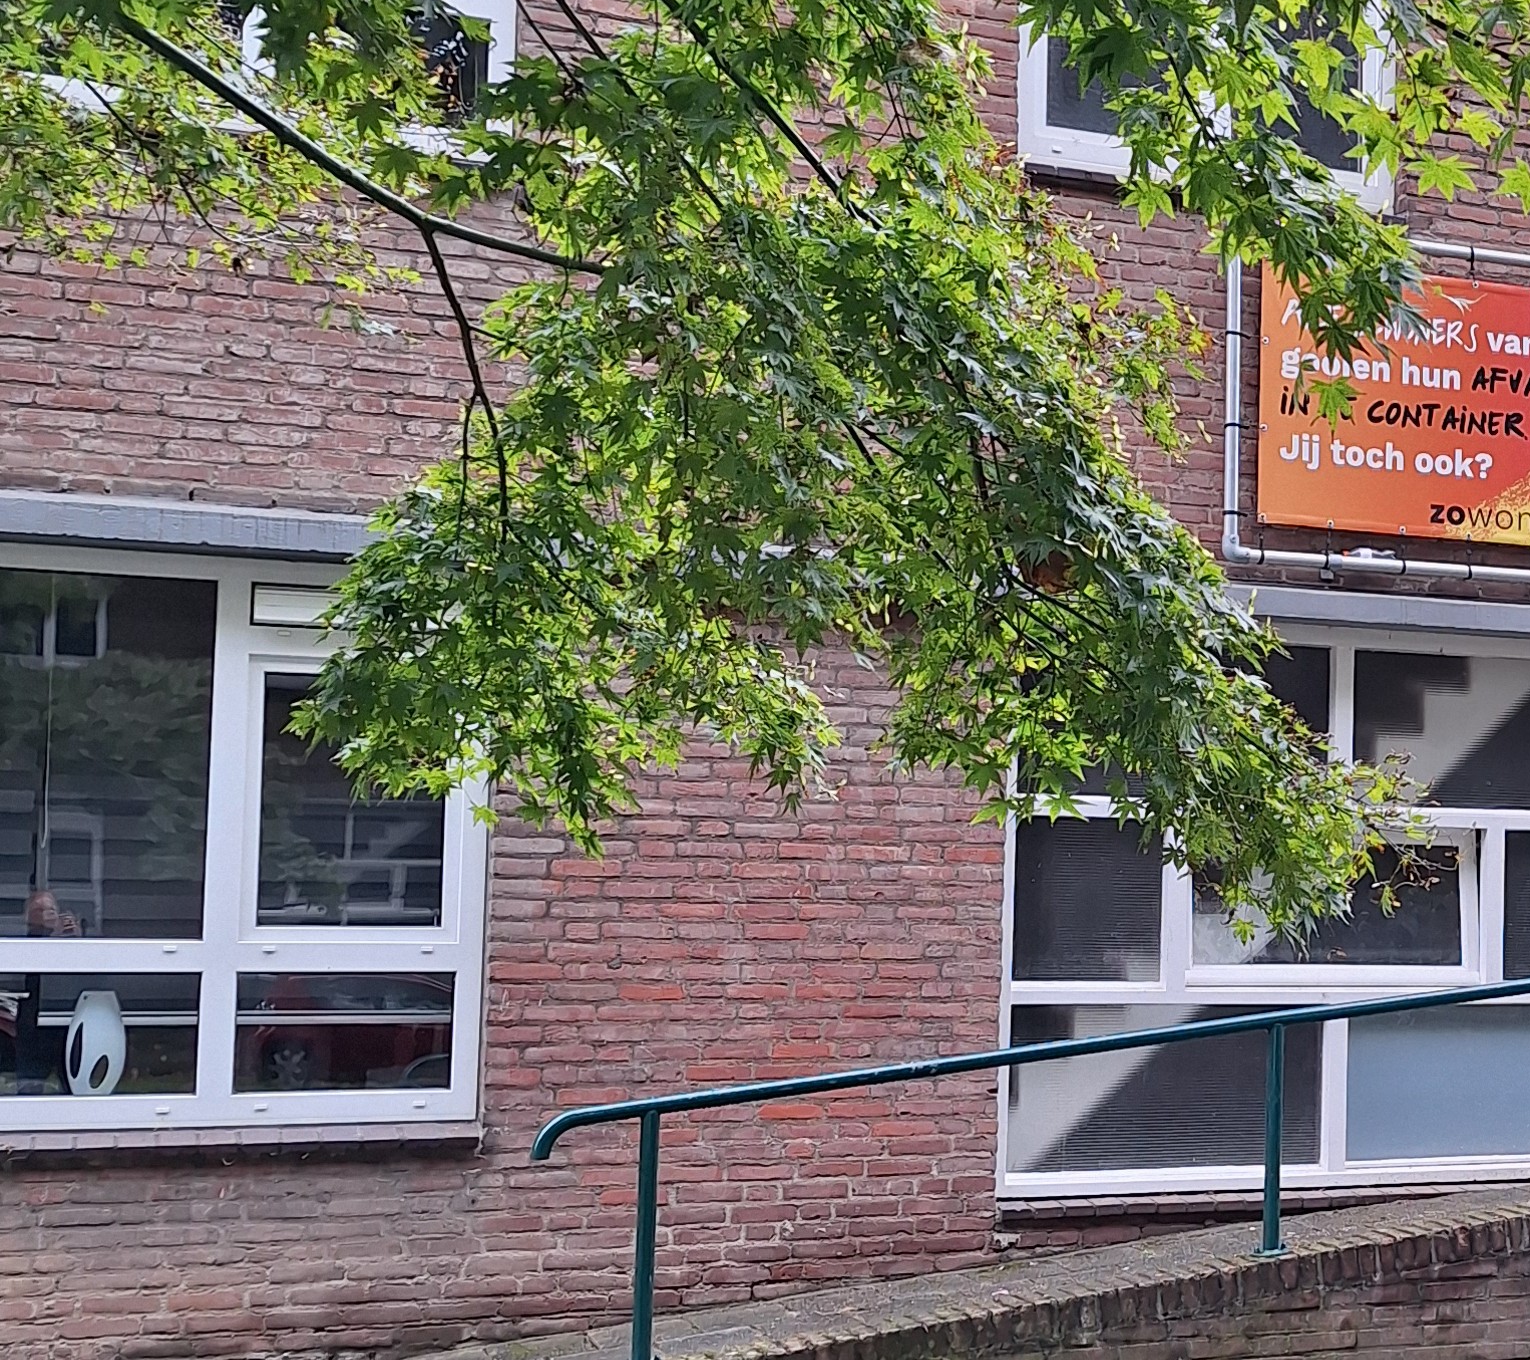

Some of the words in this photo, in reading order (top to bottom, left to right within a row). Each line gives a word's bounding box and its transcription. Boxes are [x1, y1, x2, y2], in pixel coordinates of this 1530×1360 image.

[1402, 357, 1461, 391] hun
[1279, 433, 1320, 470] Jij
[1330, 439, 1405, 471] toch
[1414, 449, 1493, 479] ook?
